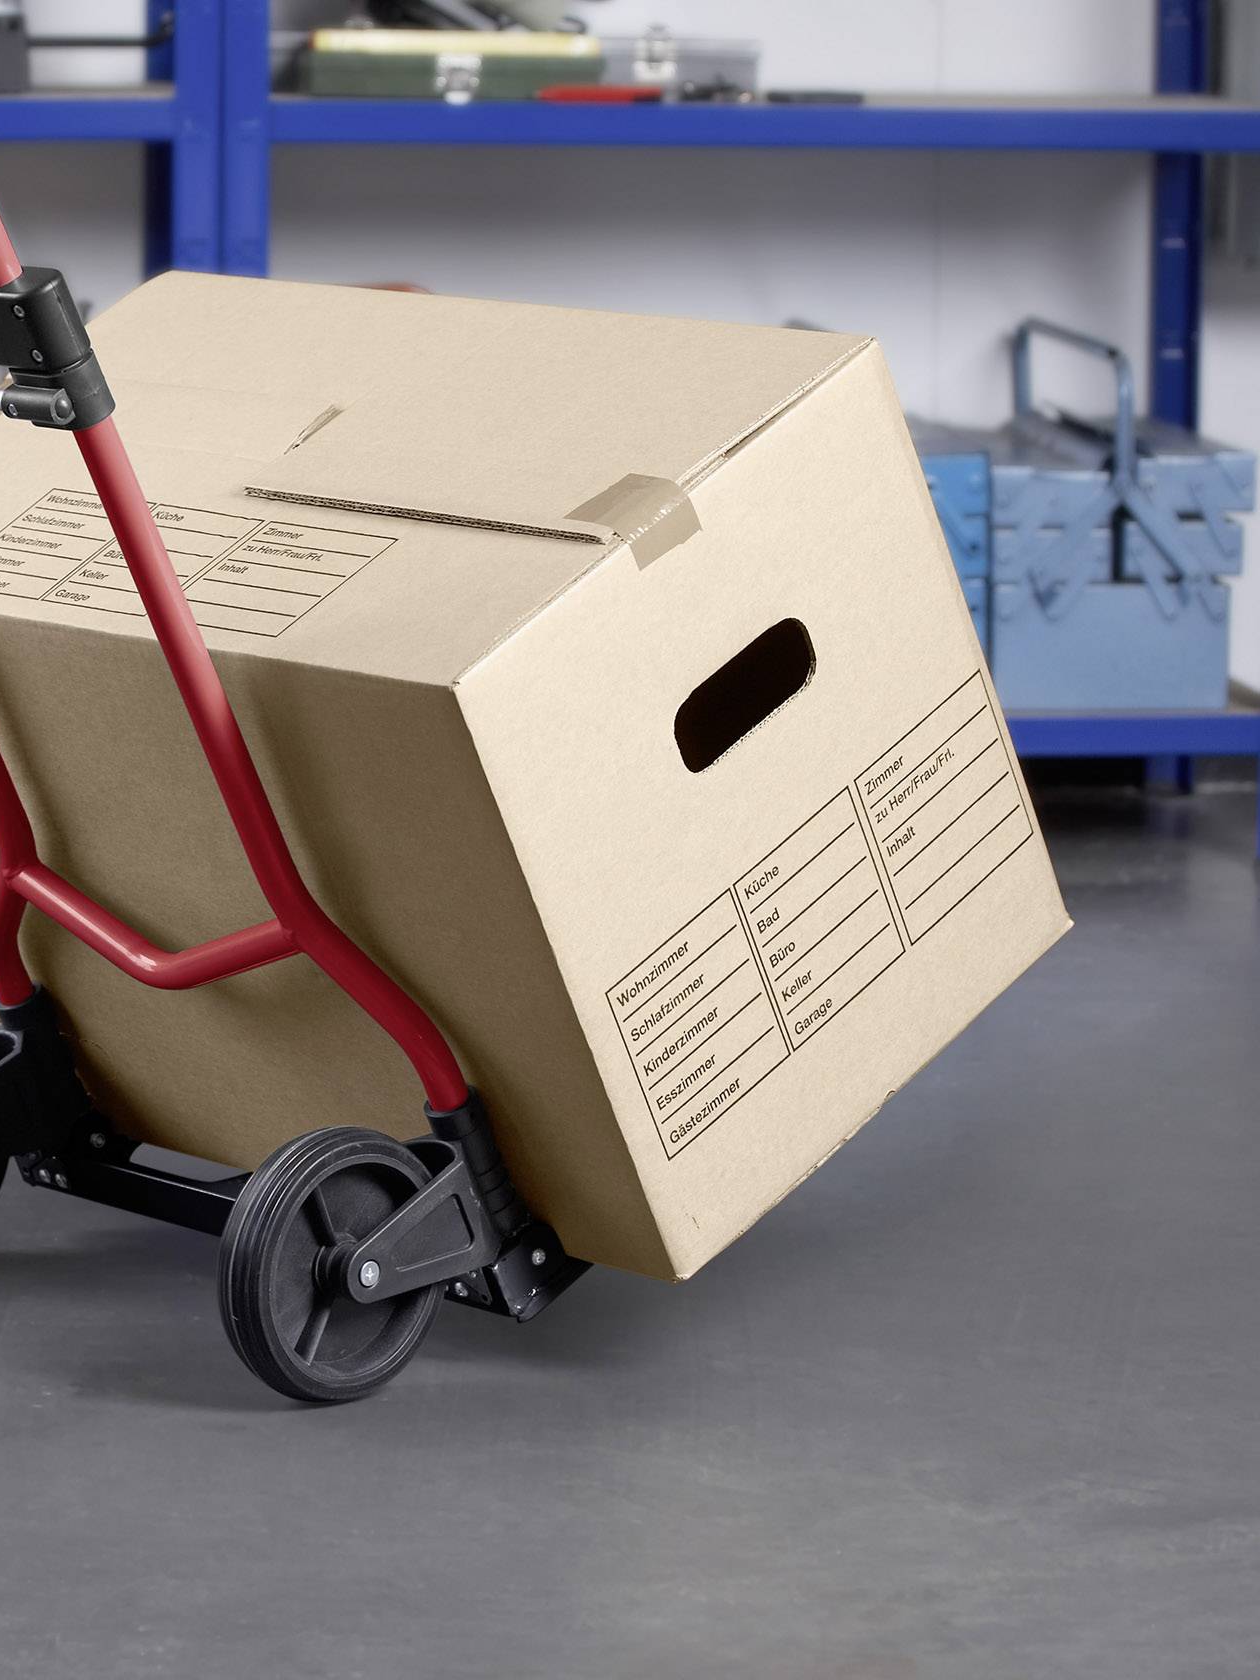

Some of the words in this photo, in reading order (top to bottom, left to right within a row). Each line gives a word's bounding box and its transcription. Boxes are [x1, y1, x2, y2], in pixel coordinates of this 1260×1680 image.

[22, 514, 85, 530] Schlafzimmer
[153, 510, 184, 522] Küche
[263, 527, 304, 540] Zimmer
[217, 563, 249, 574] Inhalt
[242, 544, 256, 552] zu
[256, 545, 323, 562] Herr/Frau/Frl.
[78, 568, 110, 581] Keller
[55, 589, 91, 602] Garage
[864, 755, 906, 796] Zimmer
[874, 805, 890, 824] zu
[888, 748, 956, 812] Herr/Frau/Frl.
[885, 826, 917, 858] Inhalt
[743, 865, 781, 900] Küche
[756, 907, 781, 935] Bad
[768, 940, 797, 969] Büro
[616, 941, 691, 1008] Wohnzimmer
[781, 970, 814, 1002] Keller
[630, 973, 706, 1043] Schlafzimmer
[793, 997, 834, 1036] Garage
[643, 1006, 720, 1077] Kinderzimmer
[656, 1053, 718, 1111] Esszimmer
[669, 1078, 744, 1145] Gästezimmer
